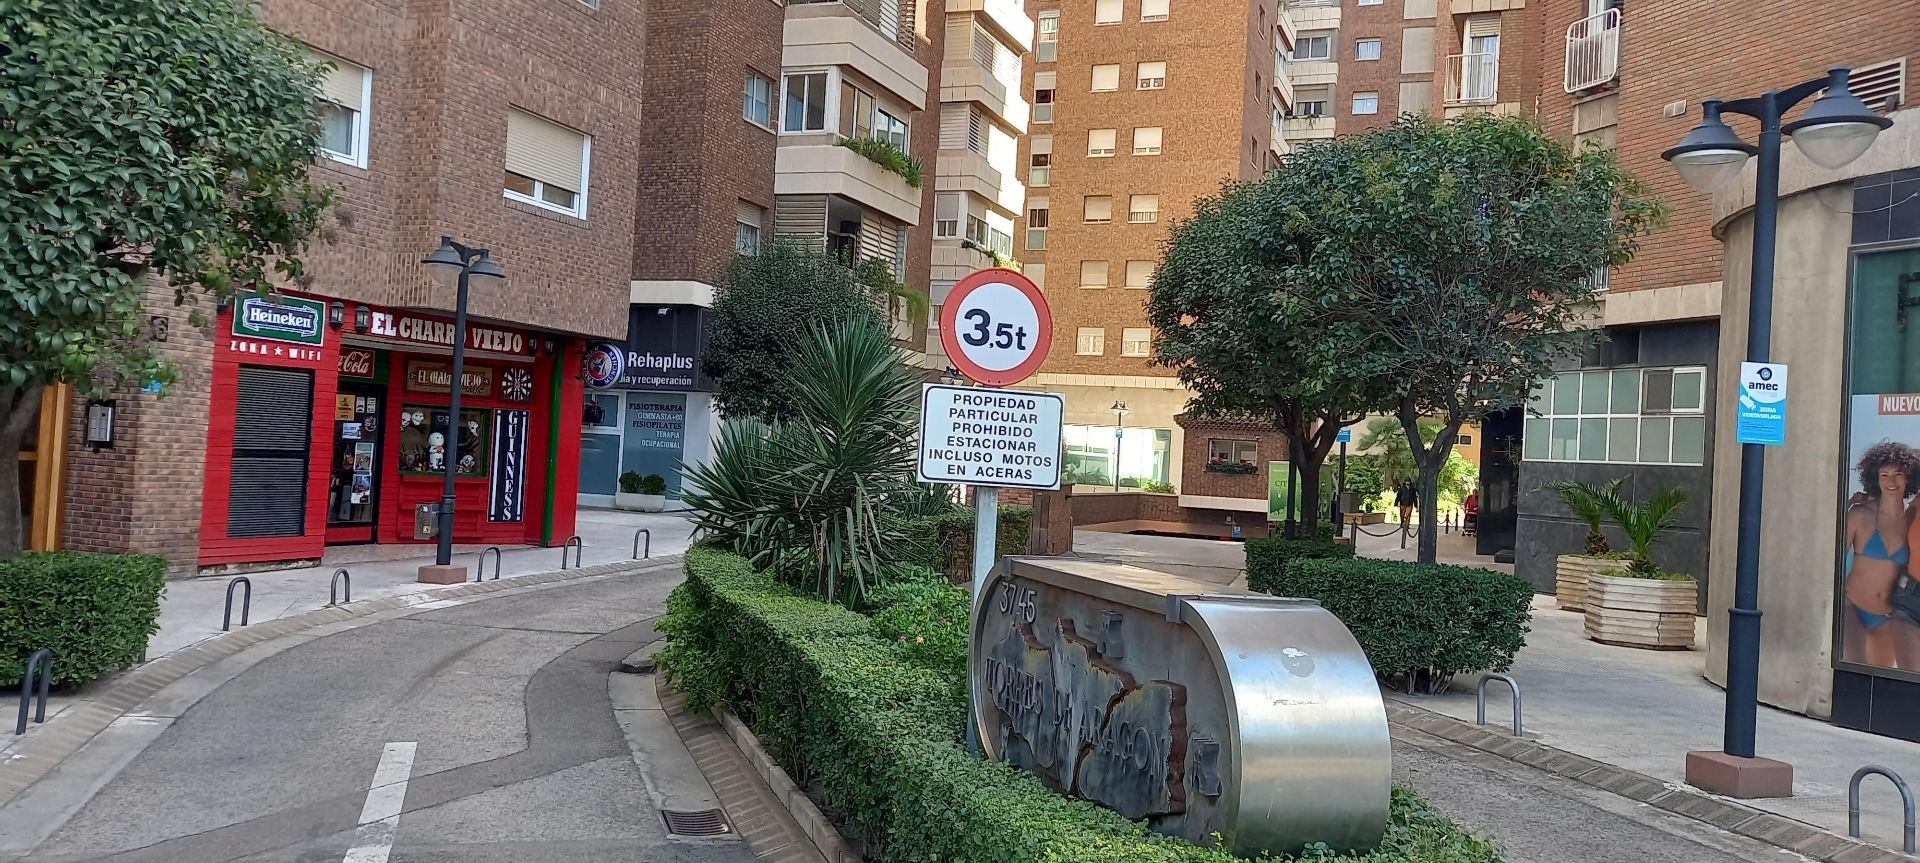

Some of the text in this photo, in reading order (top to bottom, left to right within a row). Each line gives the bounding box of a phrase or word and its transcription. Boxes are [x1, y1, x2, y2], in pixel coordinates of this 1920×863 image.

[250, 307, 312, 328] Heineken
[371, 312, 523, 353] EL CHARR VIEJO
[230, 340, 321, 361] ZONA WIFI
[627, 352, 693, 373] Rehaplus
[418, 370, 428, 384] EL
[631, 376, 637, 386] y
[638, 375, 692, 387] recuperación
[1748, 381, 1779, 391] amec
[629, 403, 683, 412] FISIOTERAPIA
[953, 394, 1036, 410] PROPIEDAD
[1883, 396, 1920, 412] NUEVO
[949, 408, 1038, 424] PARTICULAR
[632, 420, 683, 430] FISIOPILATES
[952, 422, 1033, 438] PROHIBIDO
[656, 430, 680, 439] TERAPIA
[641, 440, 680, 449] OCUPACIONAL
[946, 436, 1036, 452] ESTACIONAR
[502, 410, 519, 521] GUINNESS
[928, 449, 1052, 467] INCLUSO MOTOS
[947, 464, 1033, 480] EN ACERAS
